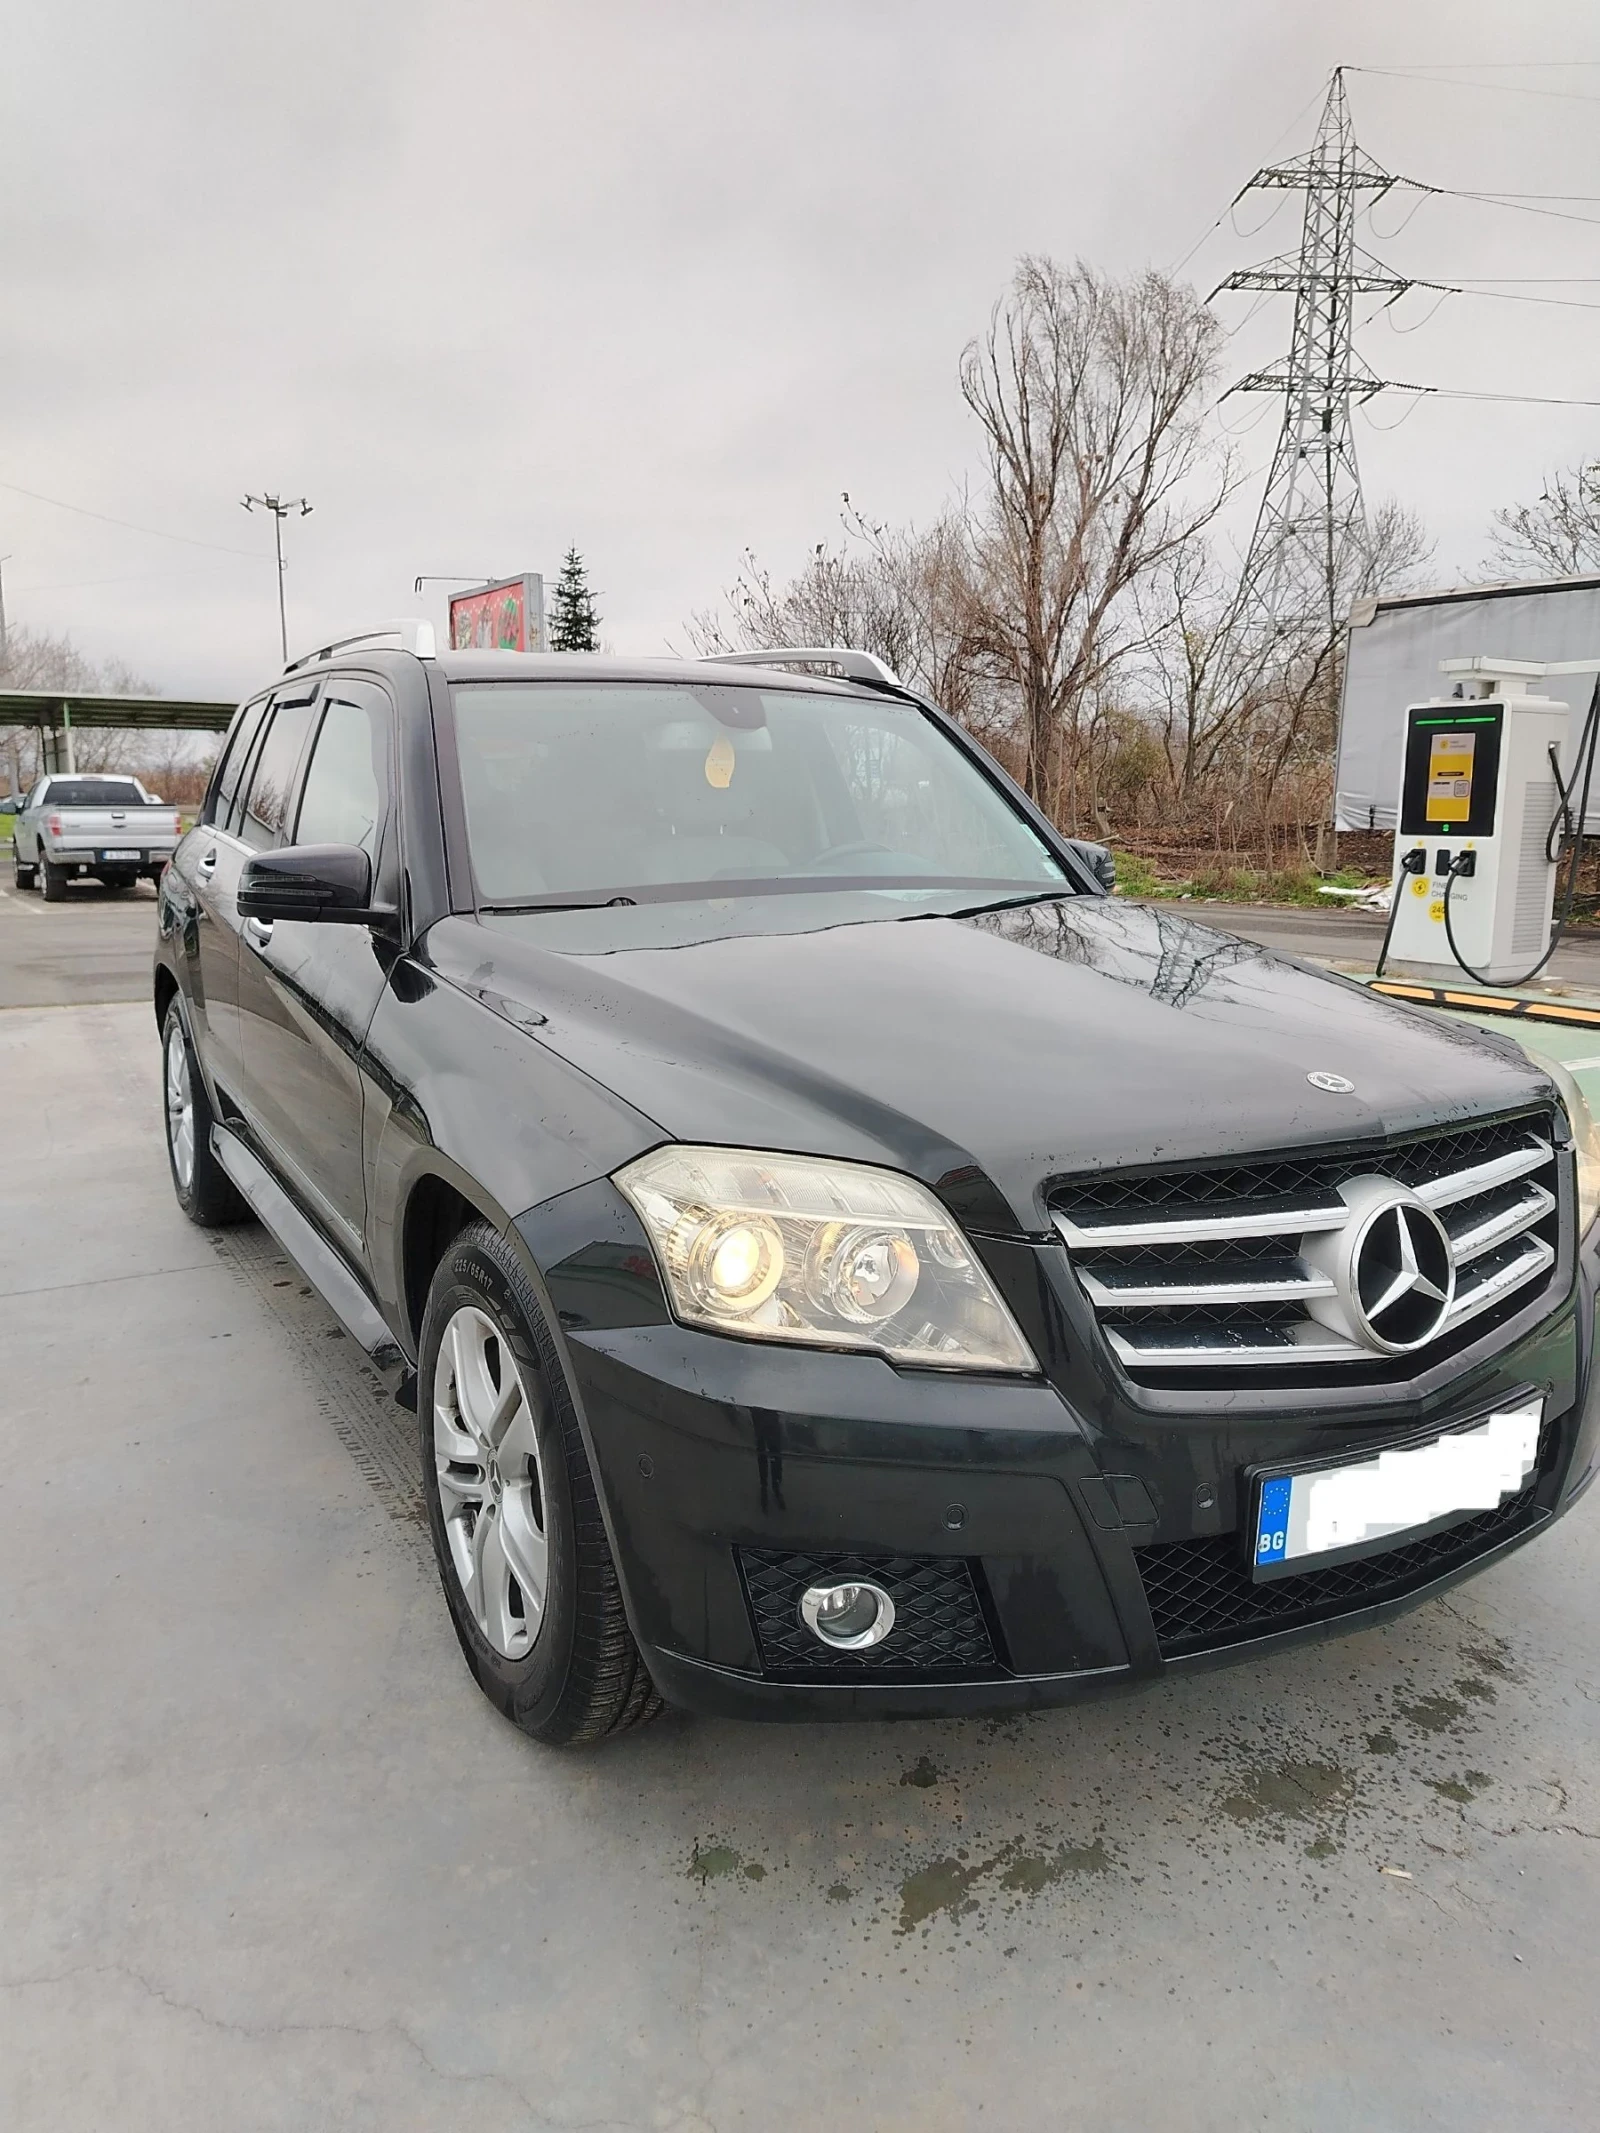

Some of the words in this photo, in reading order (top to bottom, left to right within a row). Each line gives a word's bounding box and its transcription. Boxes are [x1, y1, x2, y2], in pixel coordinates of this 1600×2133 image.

[1431, 890, 1468, 901] CHAGING
[454, 1258, 493, 1291] 225/65R17
[1258, 1530, 1285, 1553] BG
